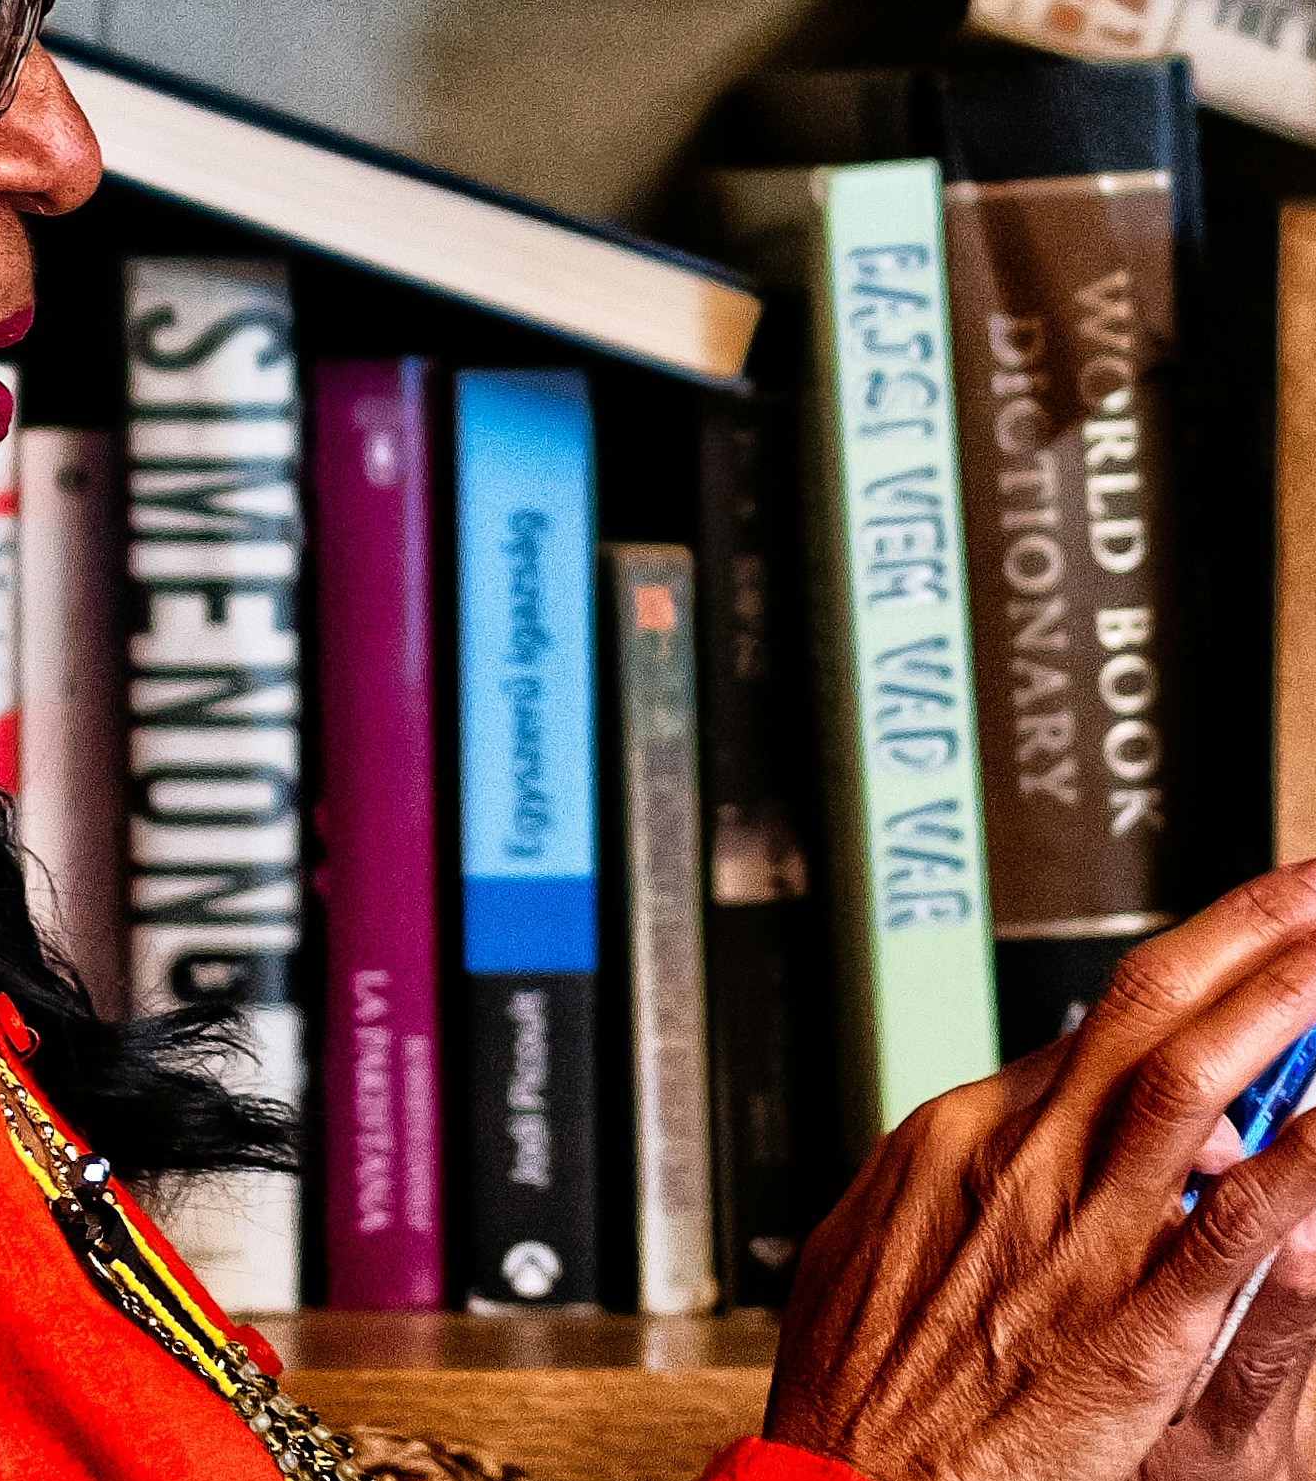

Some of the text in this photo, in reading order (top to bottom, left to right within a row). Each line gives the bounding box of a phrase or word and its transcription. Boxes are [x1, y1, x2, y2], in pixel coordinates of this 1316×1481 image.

[130, 305, 297, 925] SIMENON
[861, 463, 950, 606] VEM
[984, 311, 1080, 808] DICTIONARY
[1072, 269, 1164, 836] WORLD BOOK
[872, 633, 964, 771] VAD
[883, 797, 974, 933] VAR
